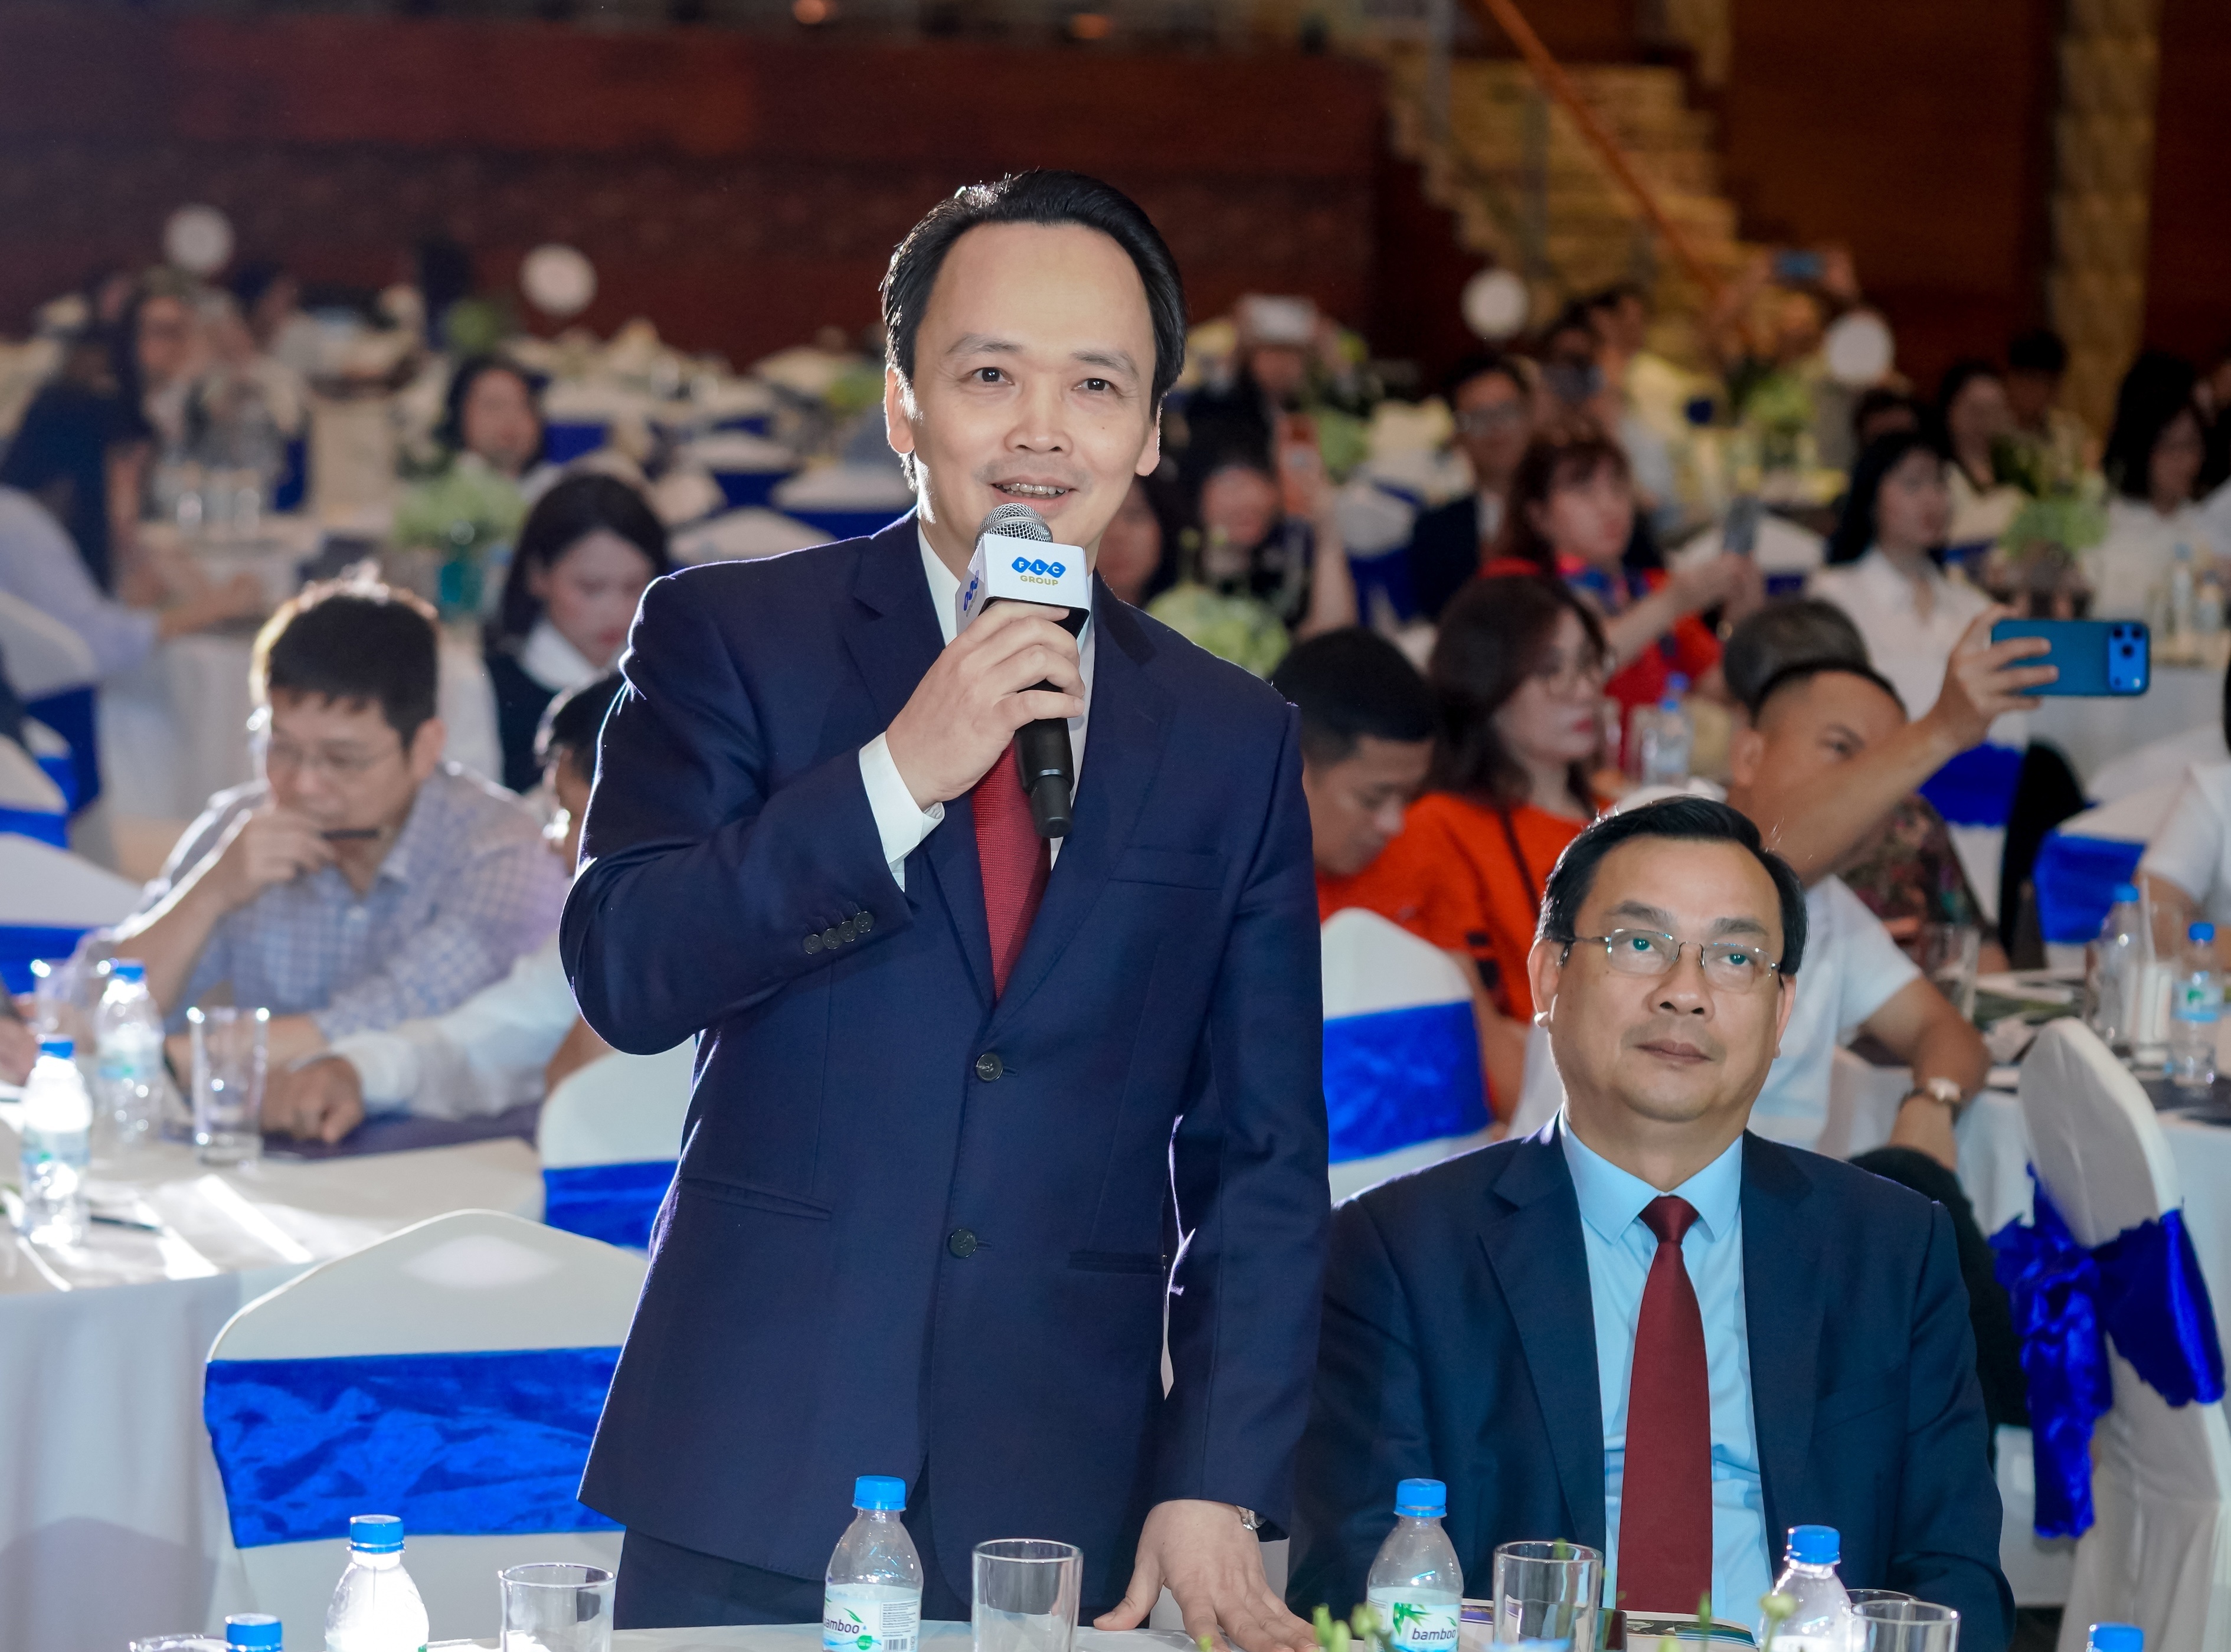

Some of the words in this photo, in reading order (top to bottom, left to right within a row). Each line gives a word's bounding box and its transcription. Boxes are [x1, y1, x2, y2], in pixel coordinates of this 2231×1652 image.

[1016, 559, 1063, 575] FLC
[1020, 575, 1059, 586] GROUP
[1412, 1628, 1456, 1641] bamboo
